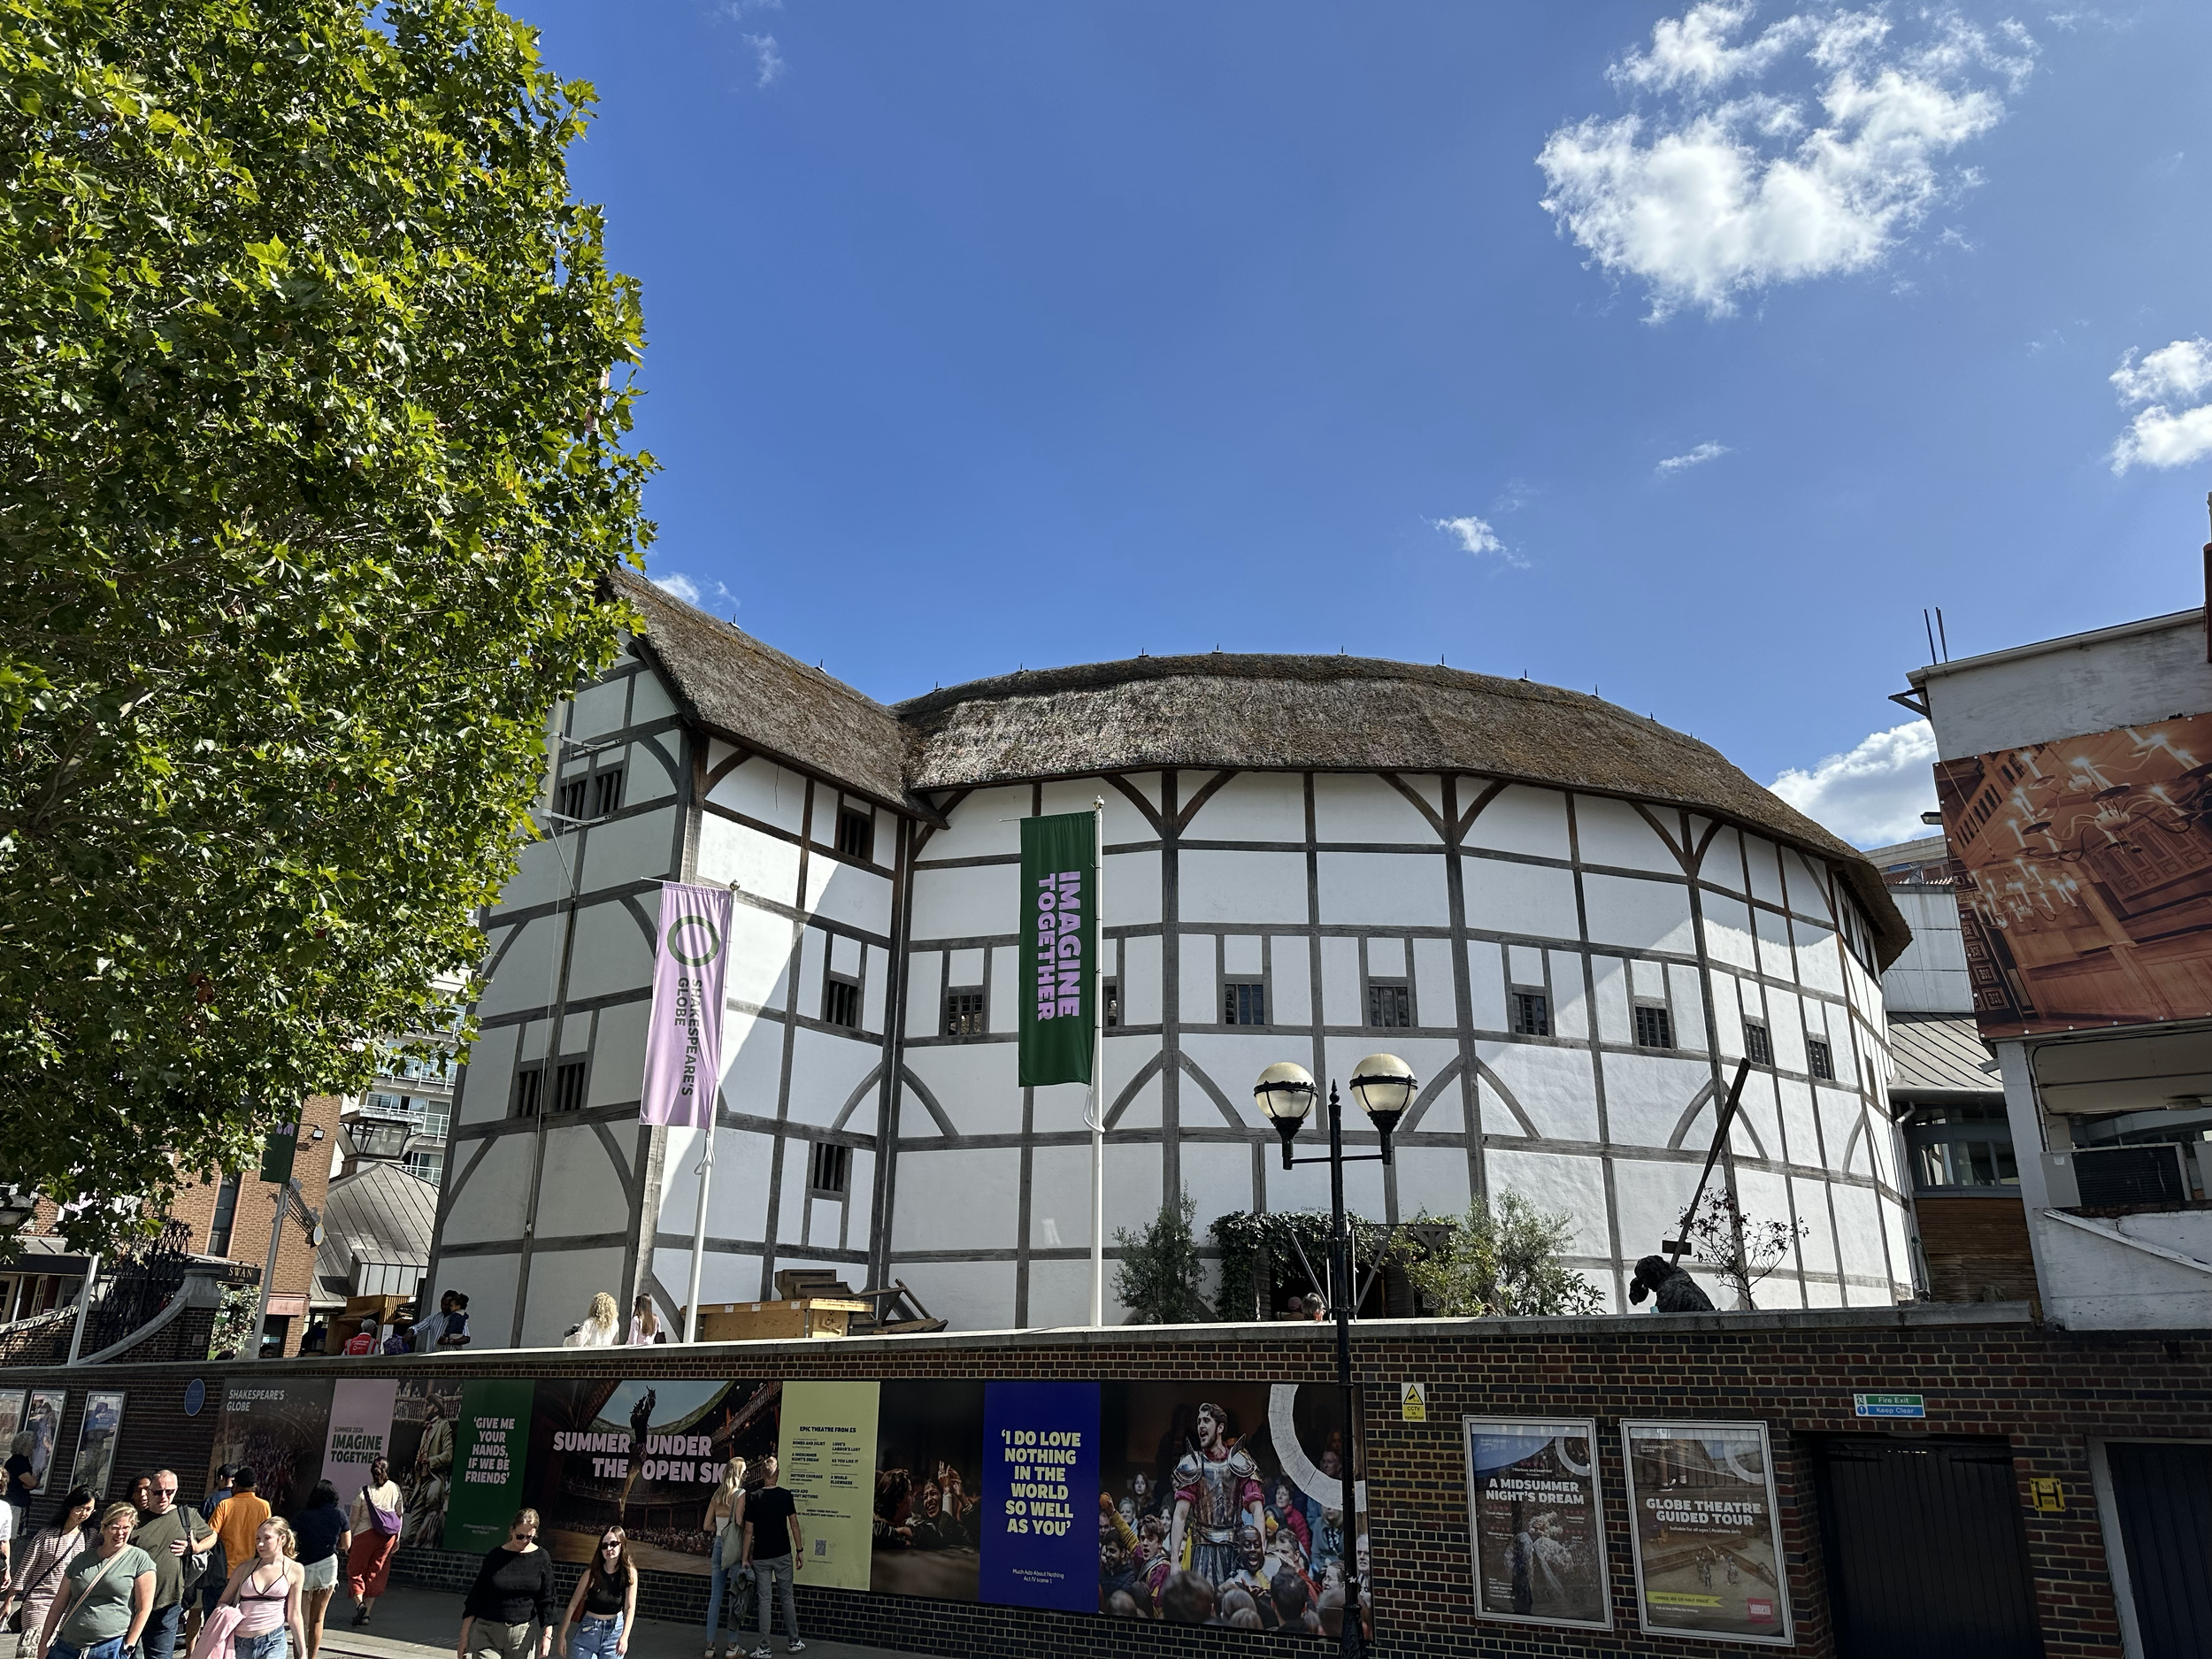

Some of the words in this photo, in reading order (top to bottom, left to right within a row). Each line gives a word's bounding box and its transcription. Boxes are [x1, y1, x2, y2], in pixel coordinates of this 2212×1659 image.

[1038, 873, 1056, 1022] TOGETHER
[1057, 871, 1082, 1018] IMAGINE
[674, 977, 689, 1026] GLOBE
[681, 979, 703, 1096] SHAKESPEARE'S
[228, 1267, 253, 1278] SWAN
[228, 1389, 285, 1400] SHAKESPEARE'S
[227, 1401, 251, 1412] GLOBE
[474, 1416, 499, 1429] ‘GIVE
[500, 1418, 515, 1429] ME
[331, 1434, 383, 1450] IMAGINE
[479, 1431, 506, 1443] YOUR
[553, 1431, 631, 1453] SUMMER
[645, 1435, 712, 1457] UNDER
[1014, 1430, 1036, 1445] DO
[1040, 1431, 1081, 1447] LOVE
[472, 1444, 508, 1458] HANDS,
[1004, 1448, 1077, 1465] NOTHING
[468, 1457, 478, 1468] IF
[480, 1459, 495, 1470] WE
[496, 1459, 510, 1470] BE
[592, 1458, 629, 1478] THE
[641, 1459, 695, 1482] OPEN
[465, 1471, 510, 1484] FRIENDS’
[1014, 1466, 1031, 1480] IN
[1034, 1466, 1066, 1482] THE
[1011, 1483, 1068, 1500] WORLD
[1489, 1478, 1498, 1488] A
[1500, 1479, 1580, 1492] MIDSUMMER
[1539, 1492, 1585, 1505] DREAM
[2035, 1482, 2061, 1508] H
[1005, 1500, 1027, 1515] SO
[1030, 1502, 1074, 1518] WELL
[1646, 1498, 1691, 1511] GLOBE
[1694, 1500, 1762, 1514] THEATRE
[1656, 1511, 1709, 1523] GUIDED
[1711, 1514, 1754, 1526] TOUR
[1007, 1518, 1028, 1534] AS
[1032, 1519, 1071, 1536] YOU’
[1047, 1571, 1064, 1579] Nothing
